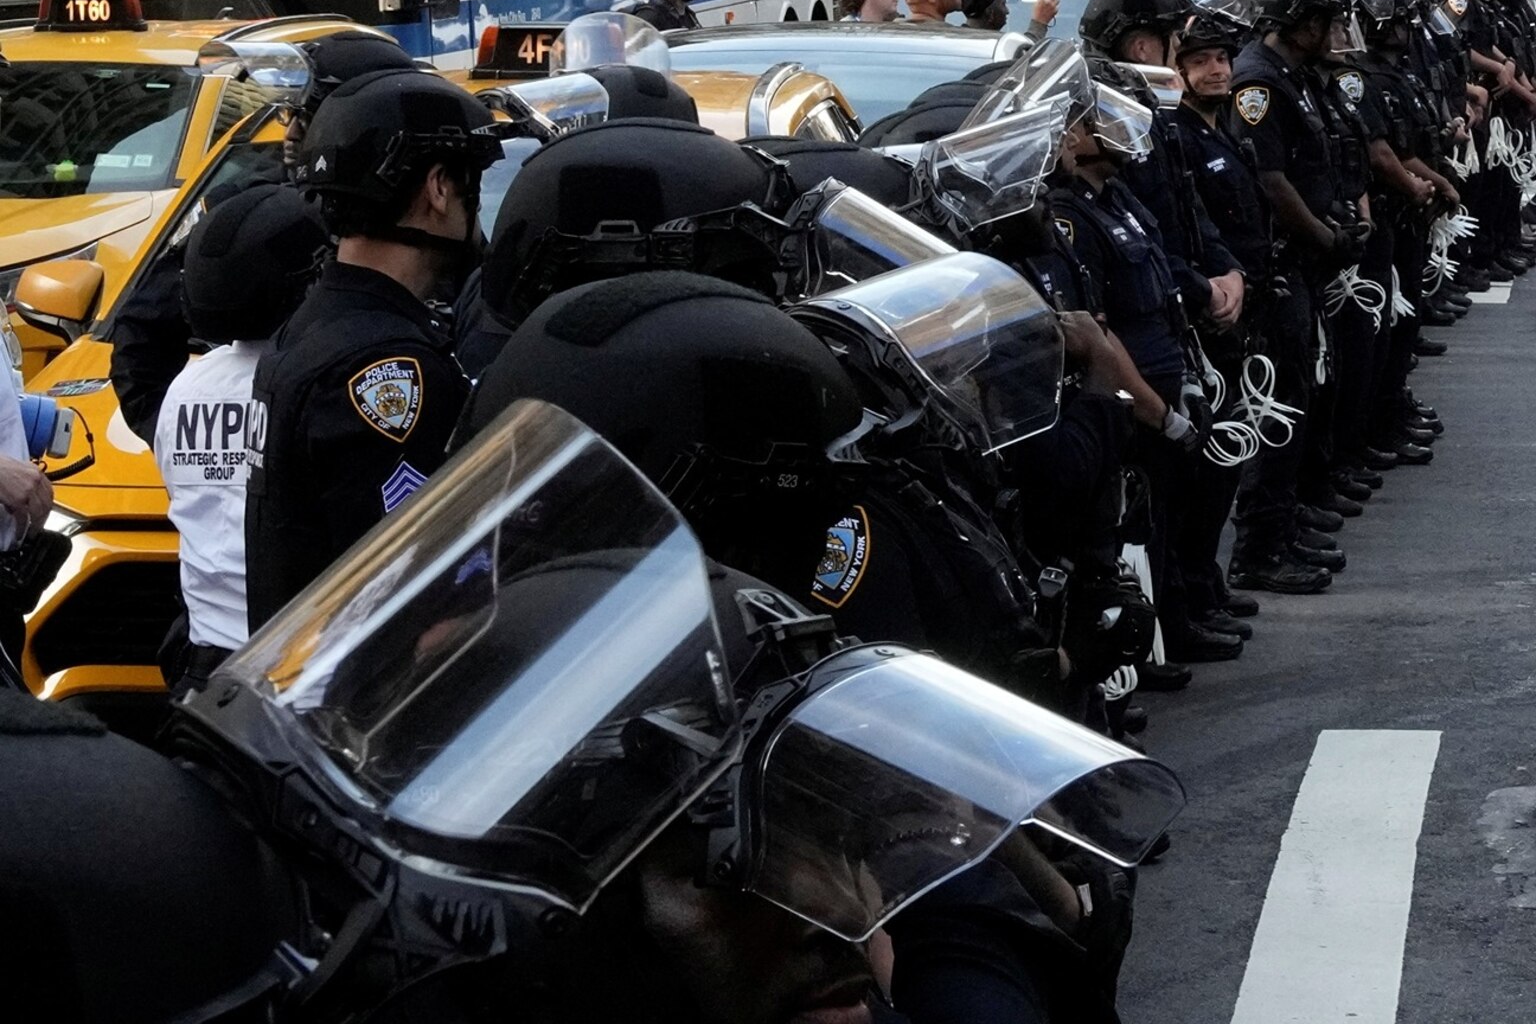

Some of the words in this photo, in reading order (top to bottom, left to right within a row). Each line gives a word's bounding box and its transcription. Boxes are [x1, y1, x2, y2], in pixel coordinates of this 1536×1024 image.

[65, 0, 111, 22] 1T60
[365, 362, 399, 379] POLICE
[355, 370, 415, 395] DEPARTMENT
[360, 403, 378, 421] CITY
[377, 419, 391, 430] OF
[402, 411, 415, 430] NEW
[411, 385, 419, 409] YORK
[176, 402, 250, 451] NYP
[173, 452, 218, 466] STRATEGIC
[204, 466, 235, 480] GROUP
[777, 474, 798, 488] 523
[840, 567, 858, 592] NEW
[853, 536, 866, 567] YORK
